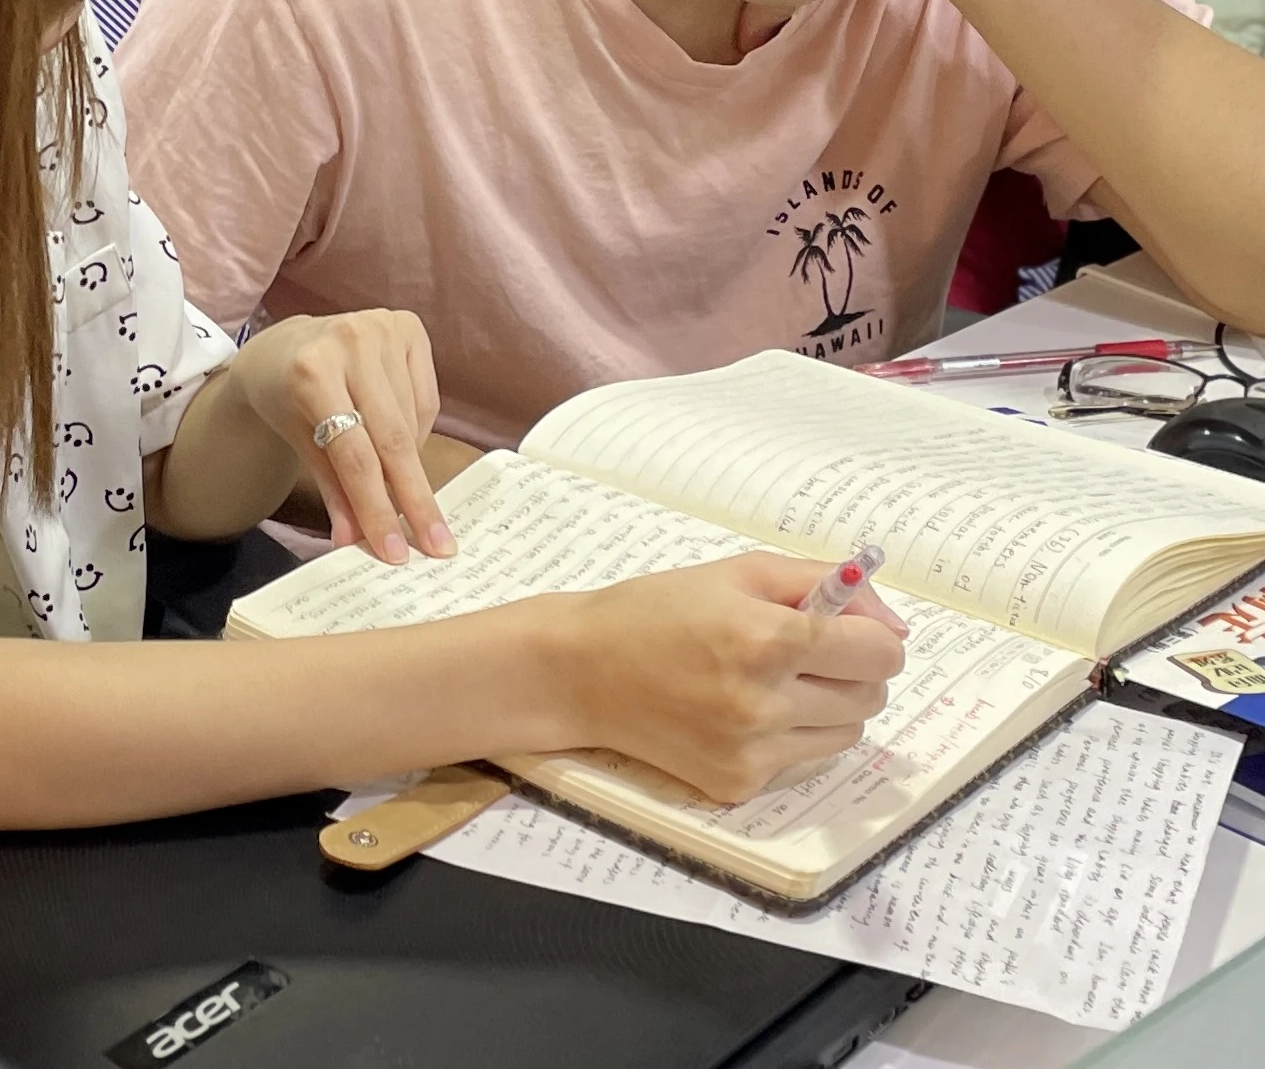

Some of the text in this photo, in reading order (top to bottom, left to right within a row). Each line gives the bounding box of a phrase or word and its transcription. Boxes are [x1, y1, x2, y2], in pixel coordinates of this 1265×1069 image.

[766, 170, 898, 235] ISLANDS OF
[778, 506, 797, 534] club
[887, 503, 920, 534] with
[932, 558, 946, 574] in
[953, 574, 971, 593] of
[1165, 880, 1184, 905] that
[146, 981, 242, 1059] acer
[1109, 997, 1126, 1020] that
